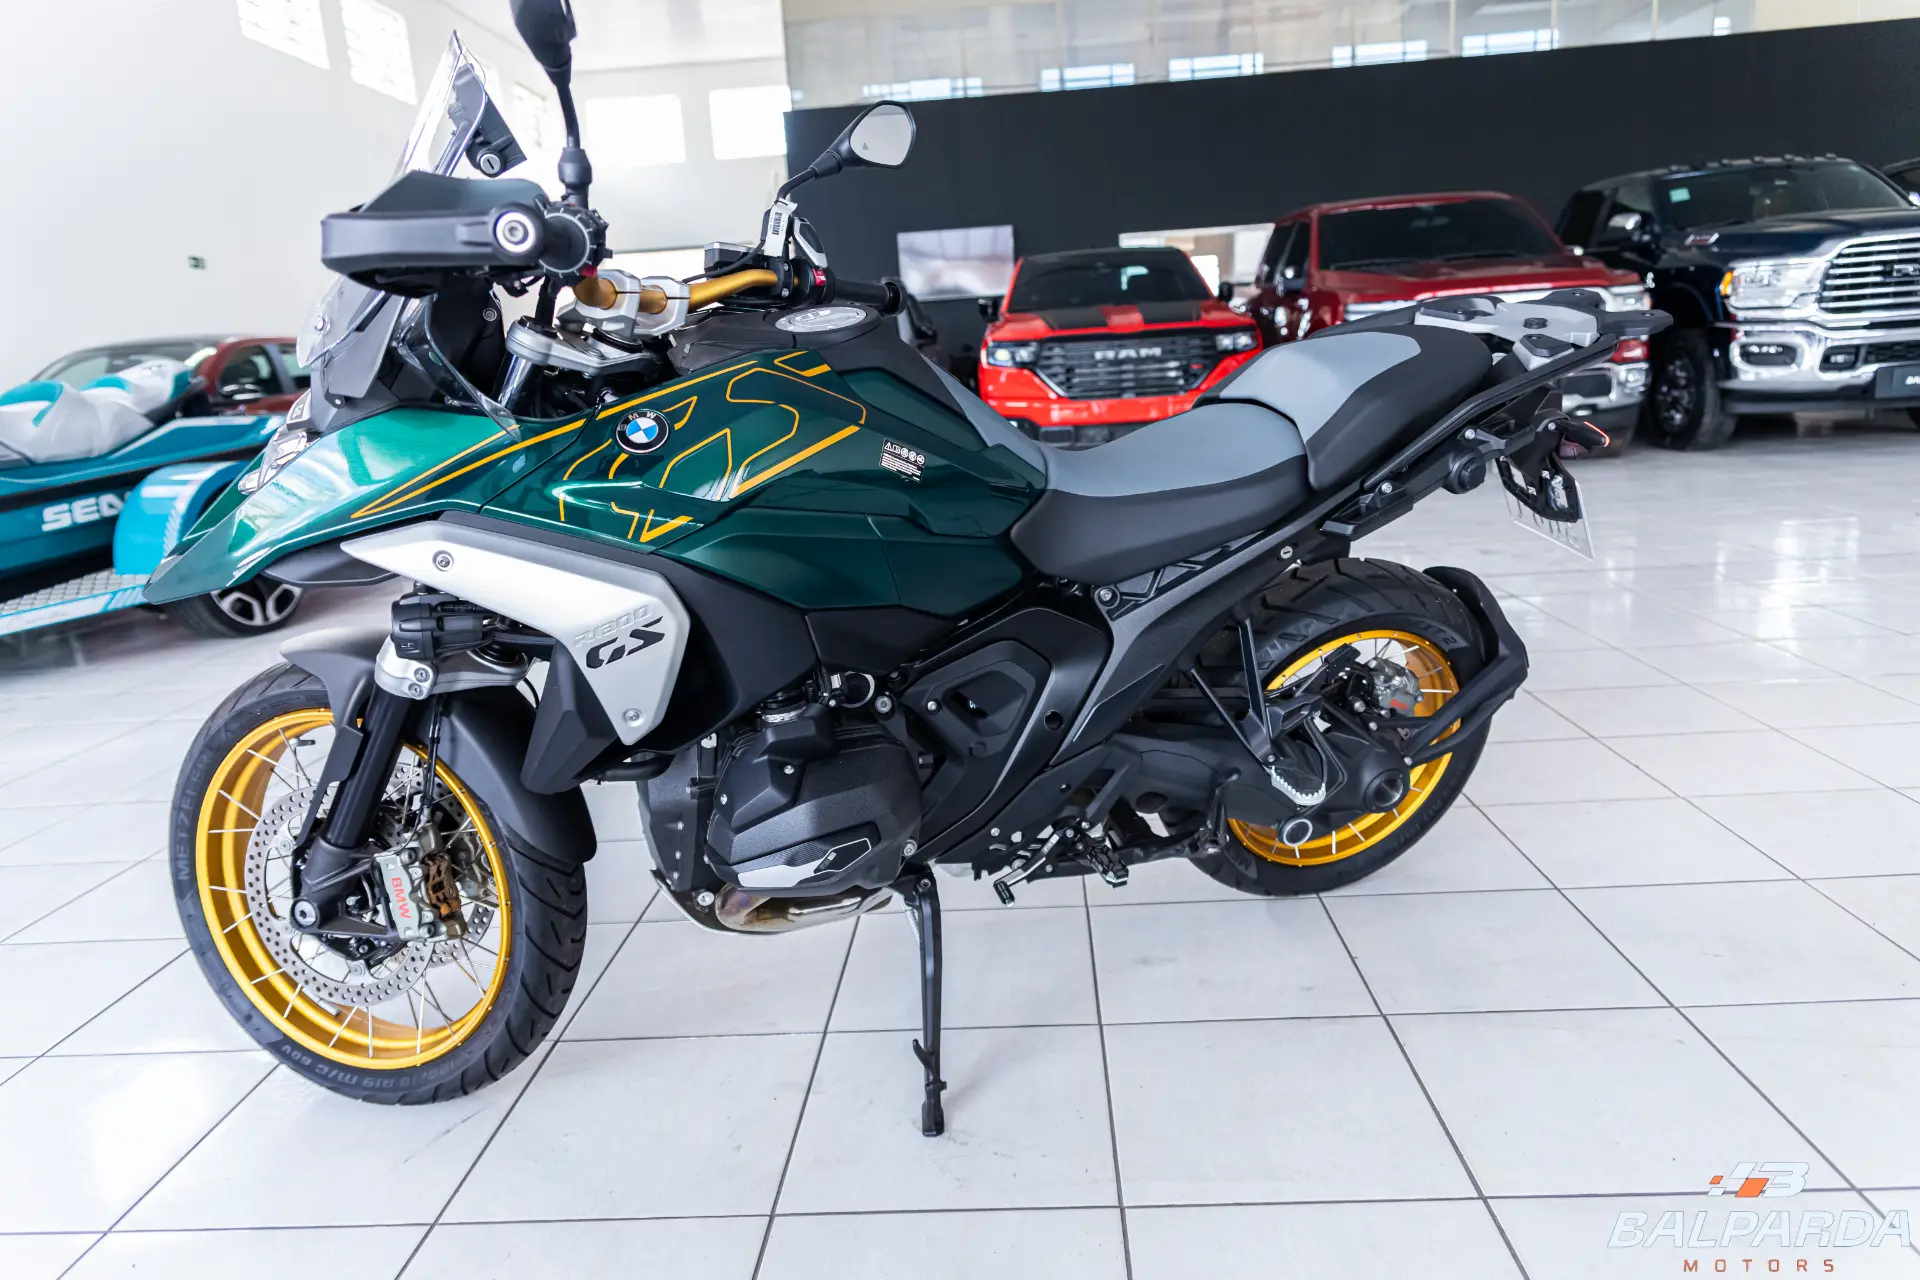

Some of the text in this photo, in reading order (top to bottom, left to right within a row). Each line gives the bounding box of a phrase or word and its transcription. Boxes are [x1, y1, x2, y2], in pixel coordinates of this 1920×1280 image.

[1094, 347, 1161, 360] RAM
[42, 490, 132, 532] SEA
[585, 615, 665, 669] GS
[391, 877, 412, 919] BMW
